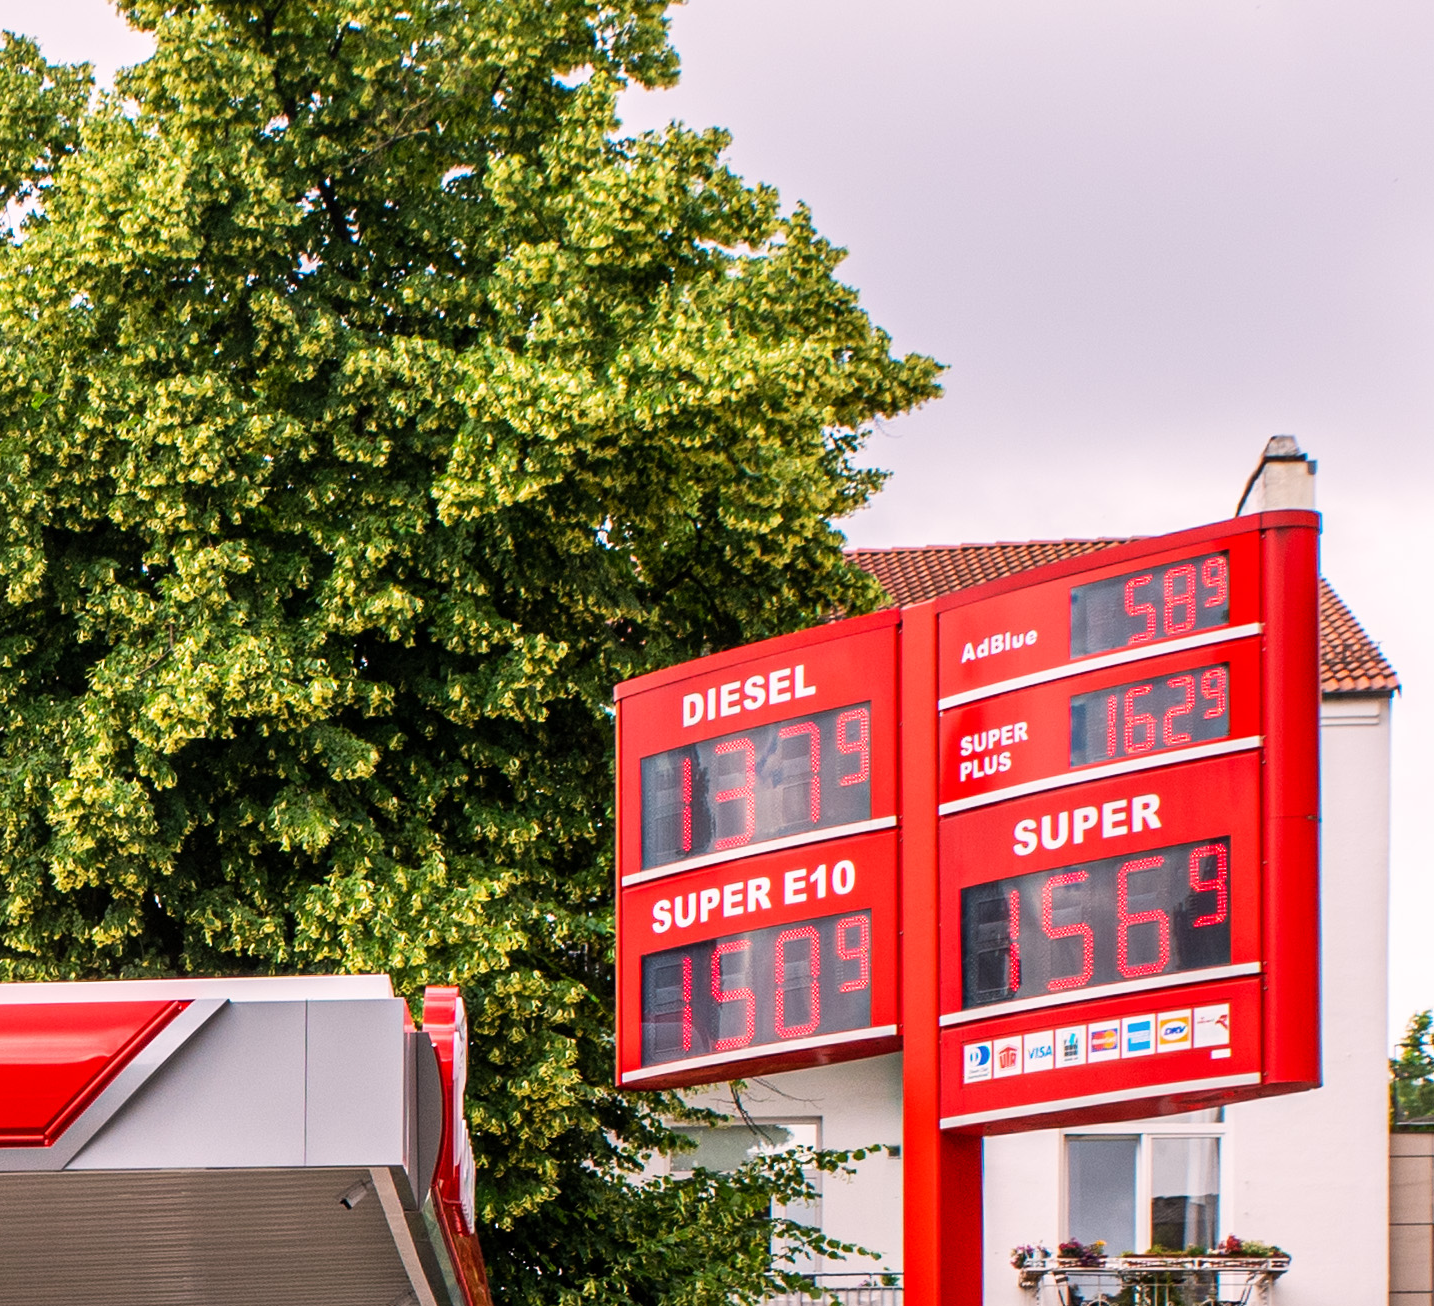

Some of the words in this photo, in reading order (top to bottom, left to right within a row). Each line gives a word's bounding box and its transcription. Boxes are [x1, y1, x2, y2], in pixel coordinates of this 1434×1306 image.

[1124, 555, 1227, 645] 589
[961, 629, 1038, 663] AdBlue
[682, 664, 817, 728] DIESEL
[1106, 666, 1227, 757] 1629
[959, 751, 1012, 782] PLUS
[960, 721, 1029, 757] SUPER
[682, 707, 870, 852] 1379
[1012, 793, 1163, 857] SUPER
[652, 876, 772, 934] SUPER
[784, 859, 856, 905] E10
[1008, 843, 1228, 992] 1569
[682, 914, 870, 1052] 1509
[1028, 1045, 1053, 1060] VISA
